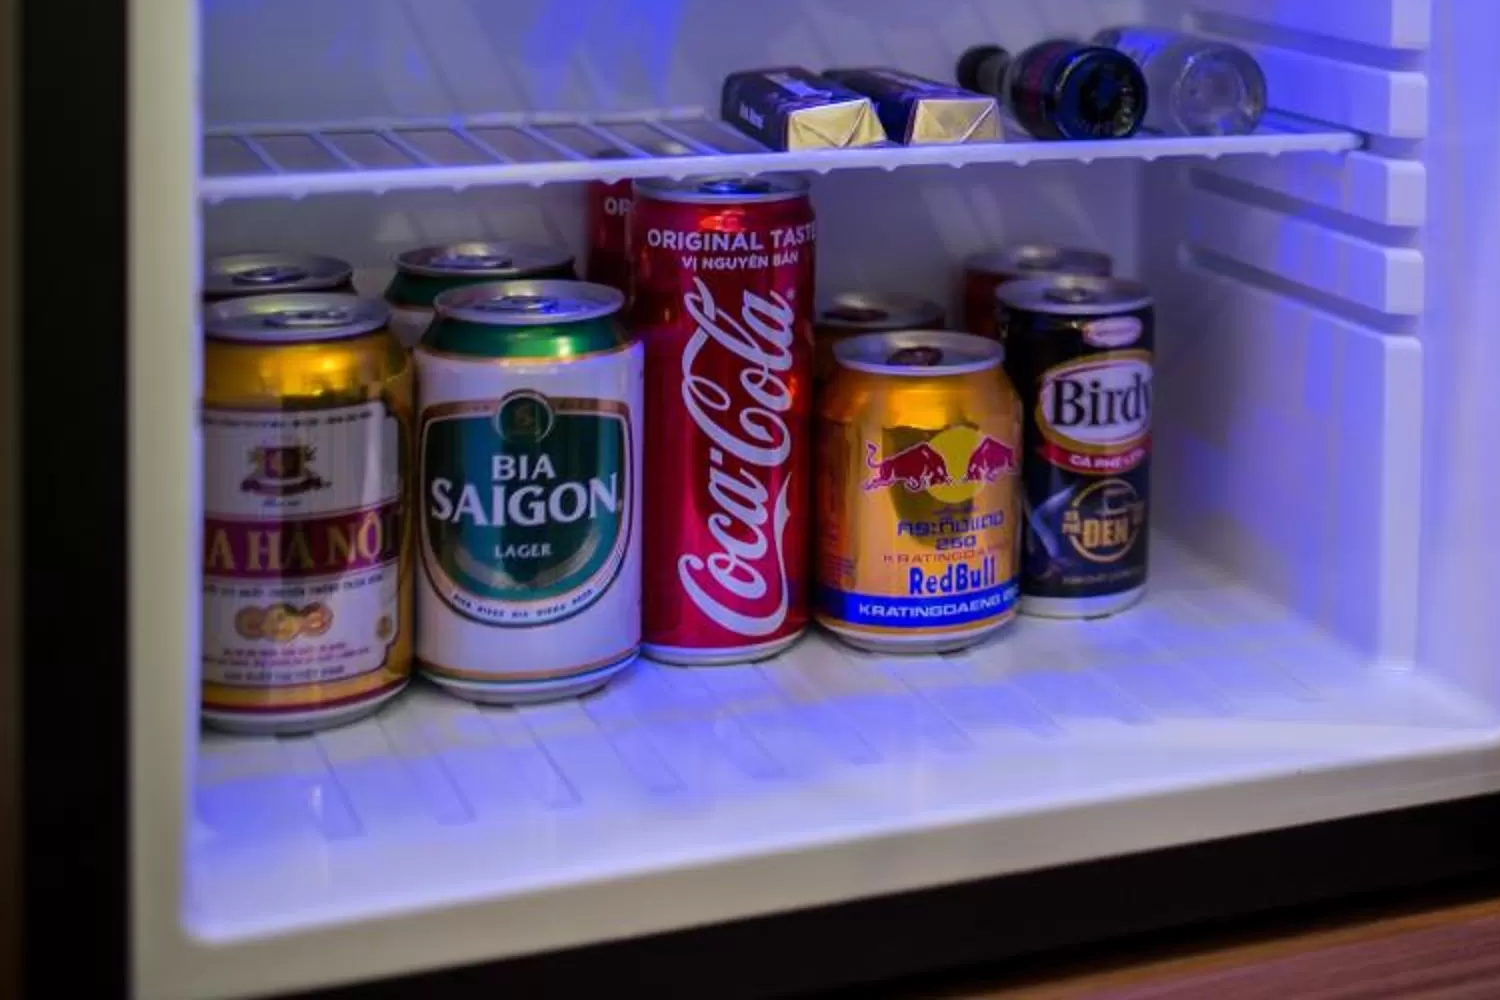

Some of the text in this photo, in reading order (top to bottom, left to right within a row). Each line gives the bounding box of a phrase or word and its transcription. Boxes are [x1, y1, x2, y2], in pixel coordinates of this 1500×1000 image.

[647, 228, 763, 251] ORIGINAL
[491, 454, 556, 481] BIA
[678, 275, 794, 637] Coca-Cola
[431, 472, 617, 527] SAIGON
[495, 543, 553, 560] LAGER
[908, 555, 996, 595] RedBull
